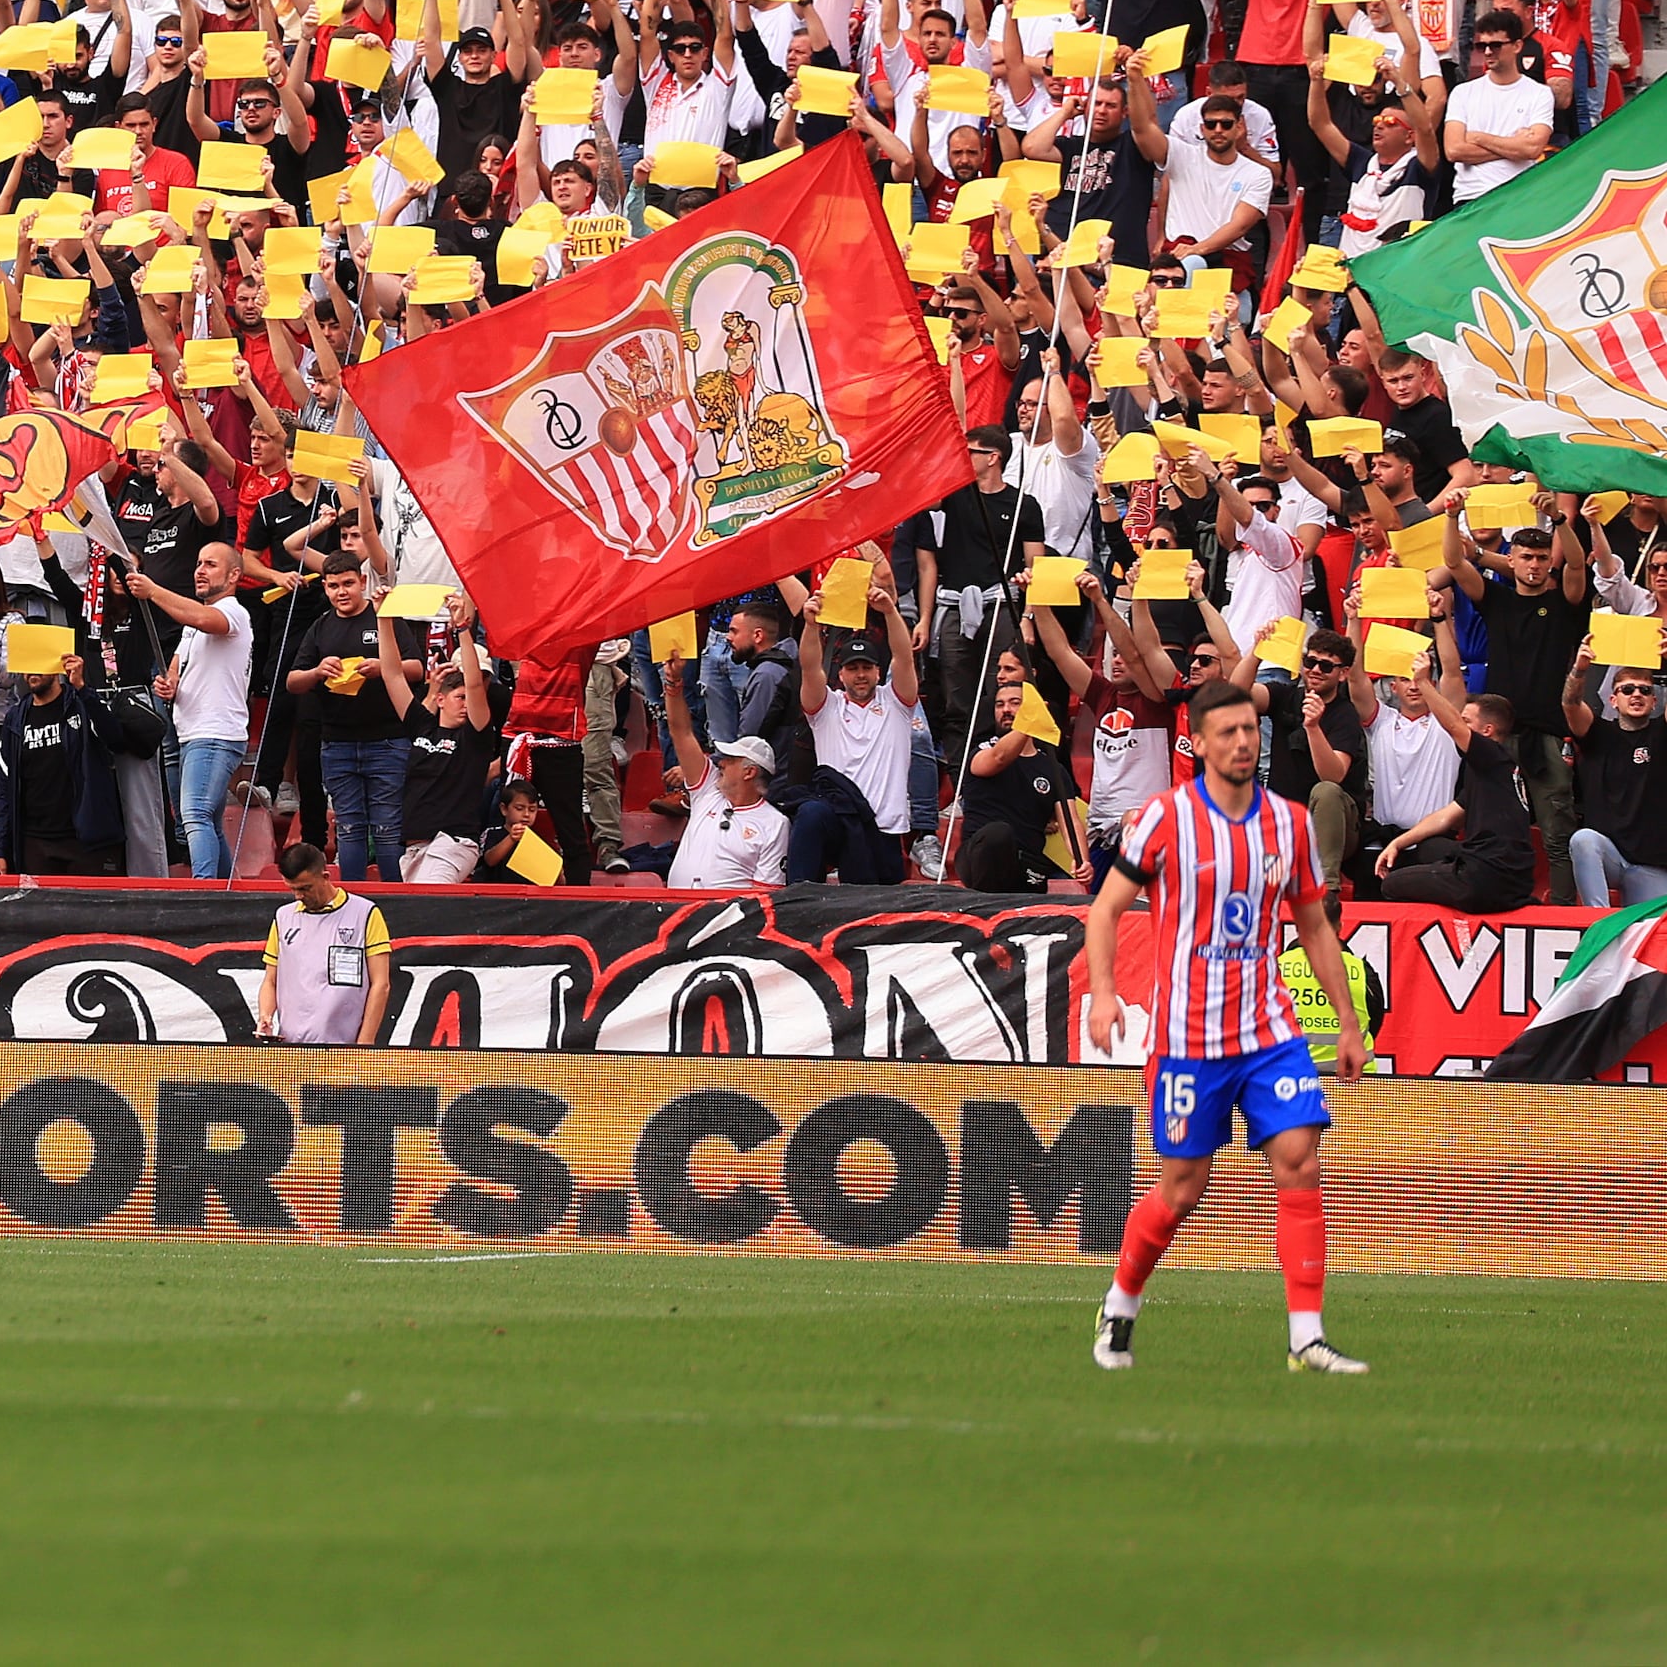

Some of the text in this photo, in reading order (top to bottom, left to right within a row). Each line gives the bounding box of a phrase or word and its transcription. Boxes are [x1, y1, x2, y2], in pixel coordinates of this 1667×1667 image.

[571, 219, 626, 236] JUNIOR
[571, 238, 604, 258] VETE
[1161, 1072, 1195, 1115] 15
